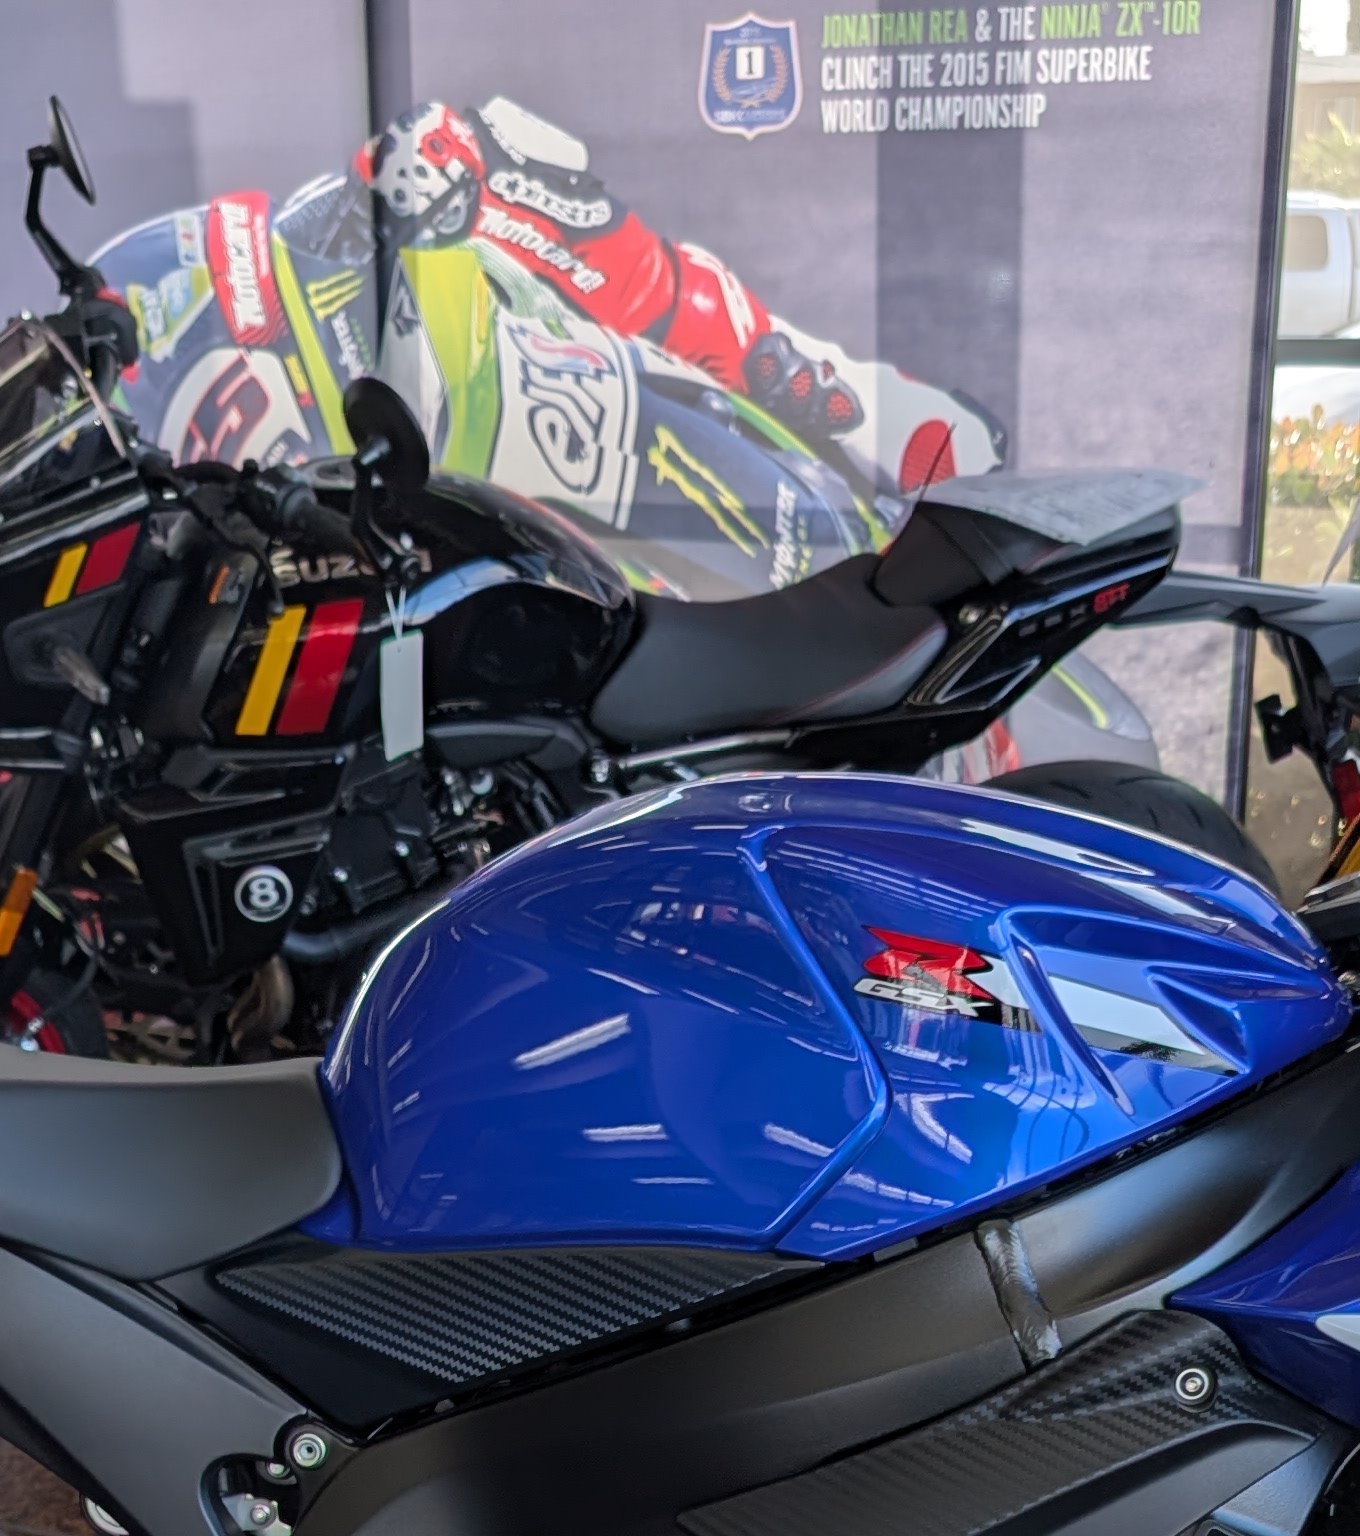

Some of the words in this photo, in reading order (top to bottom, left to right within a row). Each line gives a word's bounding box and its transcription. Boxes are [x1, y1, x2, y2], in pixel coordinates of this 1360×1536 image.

[821, 10, 923, 48] JONATHAN
[928, 8, 969, 43] REA
[974, 9, 992, 42] &
[997, 7, 1036, 41] THE
[821, 56, 892, 91] CLINCH
[898, 54, 935, 88] THE
[940, 52, 989, 87] 2015
[995, 50, 1032, 85] FIM
[1036, 46, 1153, 83] SUPERBIKE
[821, 98, 889, 133] WORLD
[894, 93, 1047, 131] CHAMPIONSHIP
[248, 877, 280, 909] 8
[853, 977, 994, 1018] GSX
